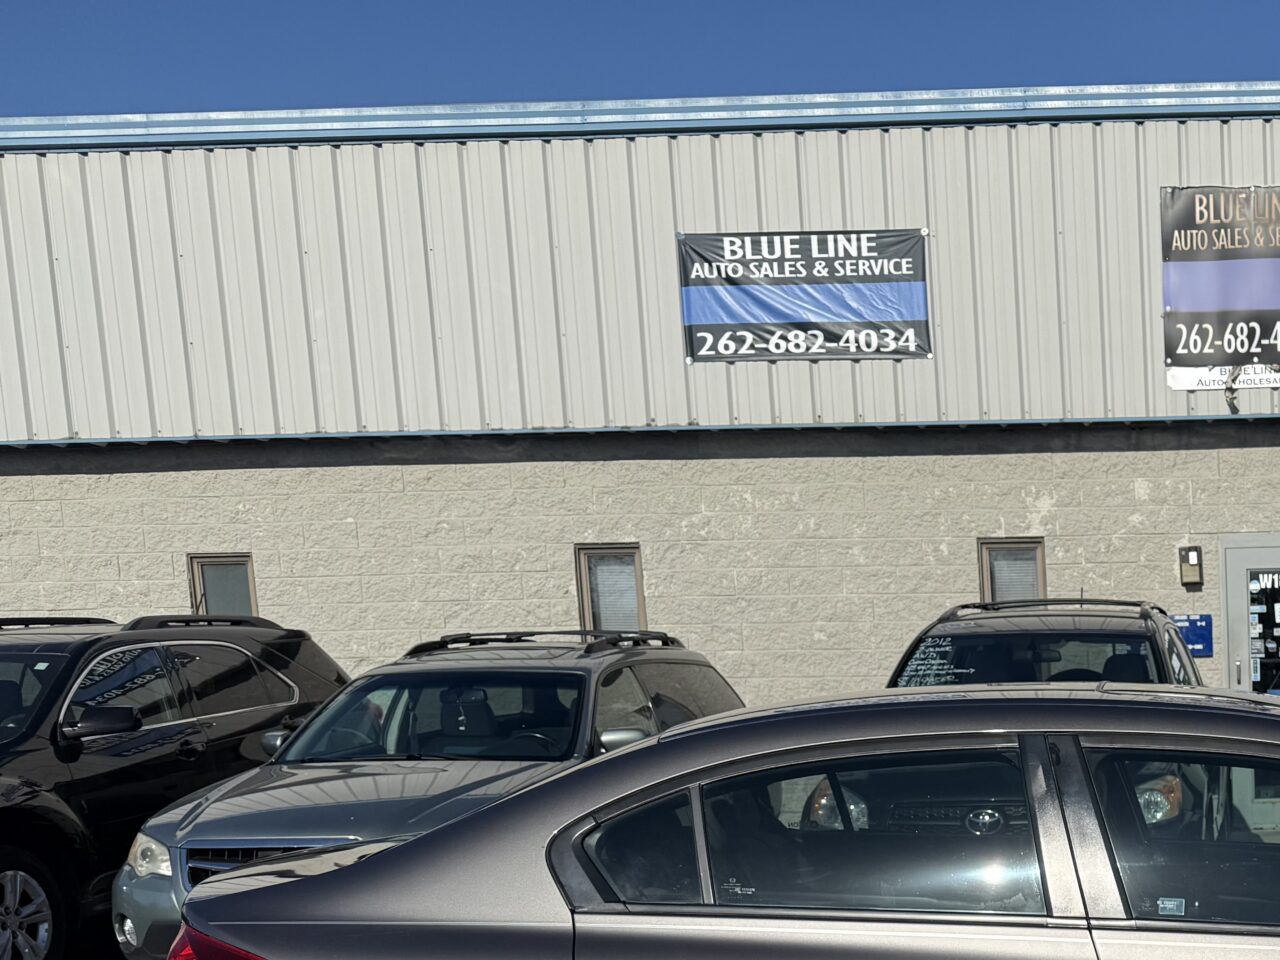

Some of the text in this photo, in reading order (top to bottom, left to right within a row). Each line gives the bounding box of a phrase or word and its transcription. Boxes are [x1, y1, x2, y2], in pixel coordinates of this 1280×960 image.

[1195, 192, 1246, 224] BLUE
[722, 233, 878, 260] BLUE LINE
[1172, 229, 1208, 251] AUTO
[1212, 228, 1250, 249] SALES
[1254, 227, 1264, 248] &
[691, 258, 914, 279] AUTO SALES & SERVICE
[696, 328, 918, 356] 262-682-4034
[1220, 365, 1278, 376] BE LIN
